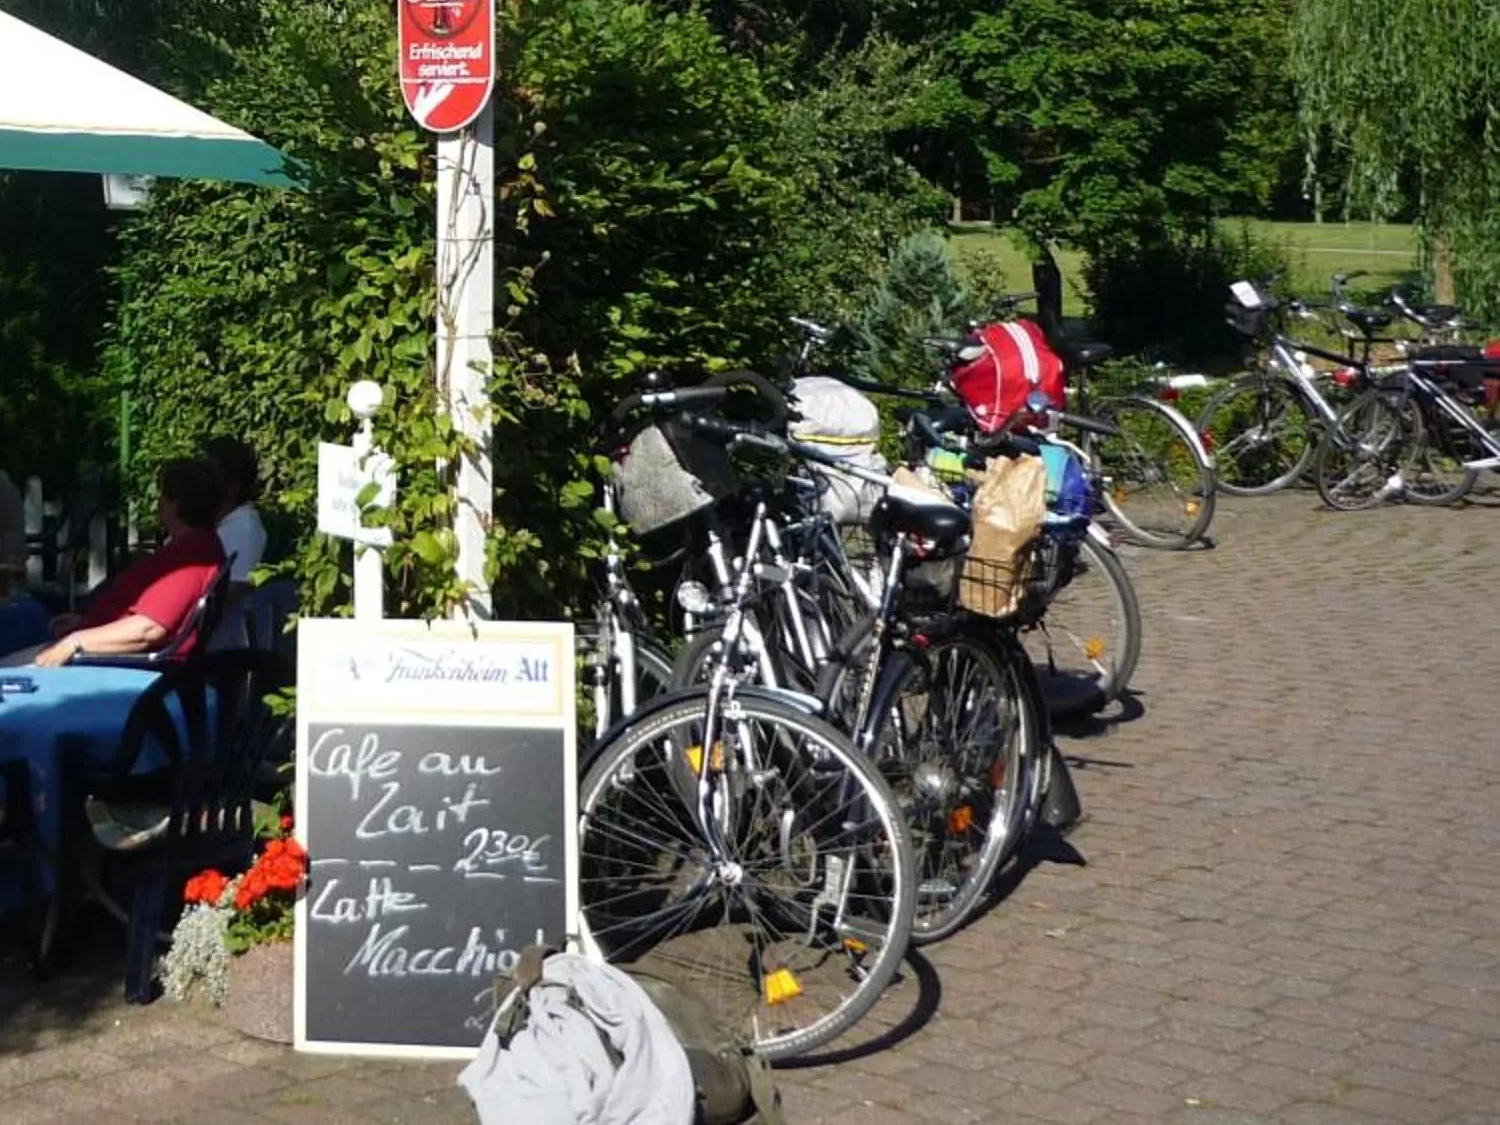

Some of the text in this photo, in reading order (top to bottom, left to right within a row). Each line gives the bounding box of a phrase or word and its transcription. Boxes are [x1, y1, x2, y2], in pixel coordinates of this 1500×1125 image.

[409, 42, 483, 60] Erfrischend
[385, 646, 549, 684] Frankenheim Alt
[309, 728, 503, 801] Cafe au
[310, 877, 428, 923] Latte
